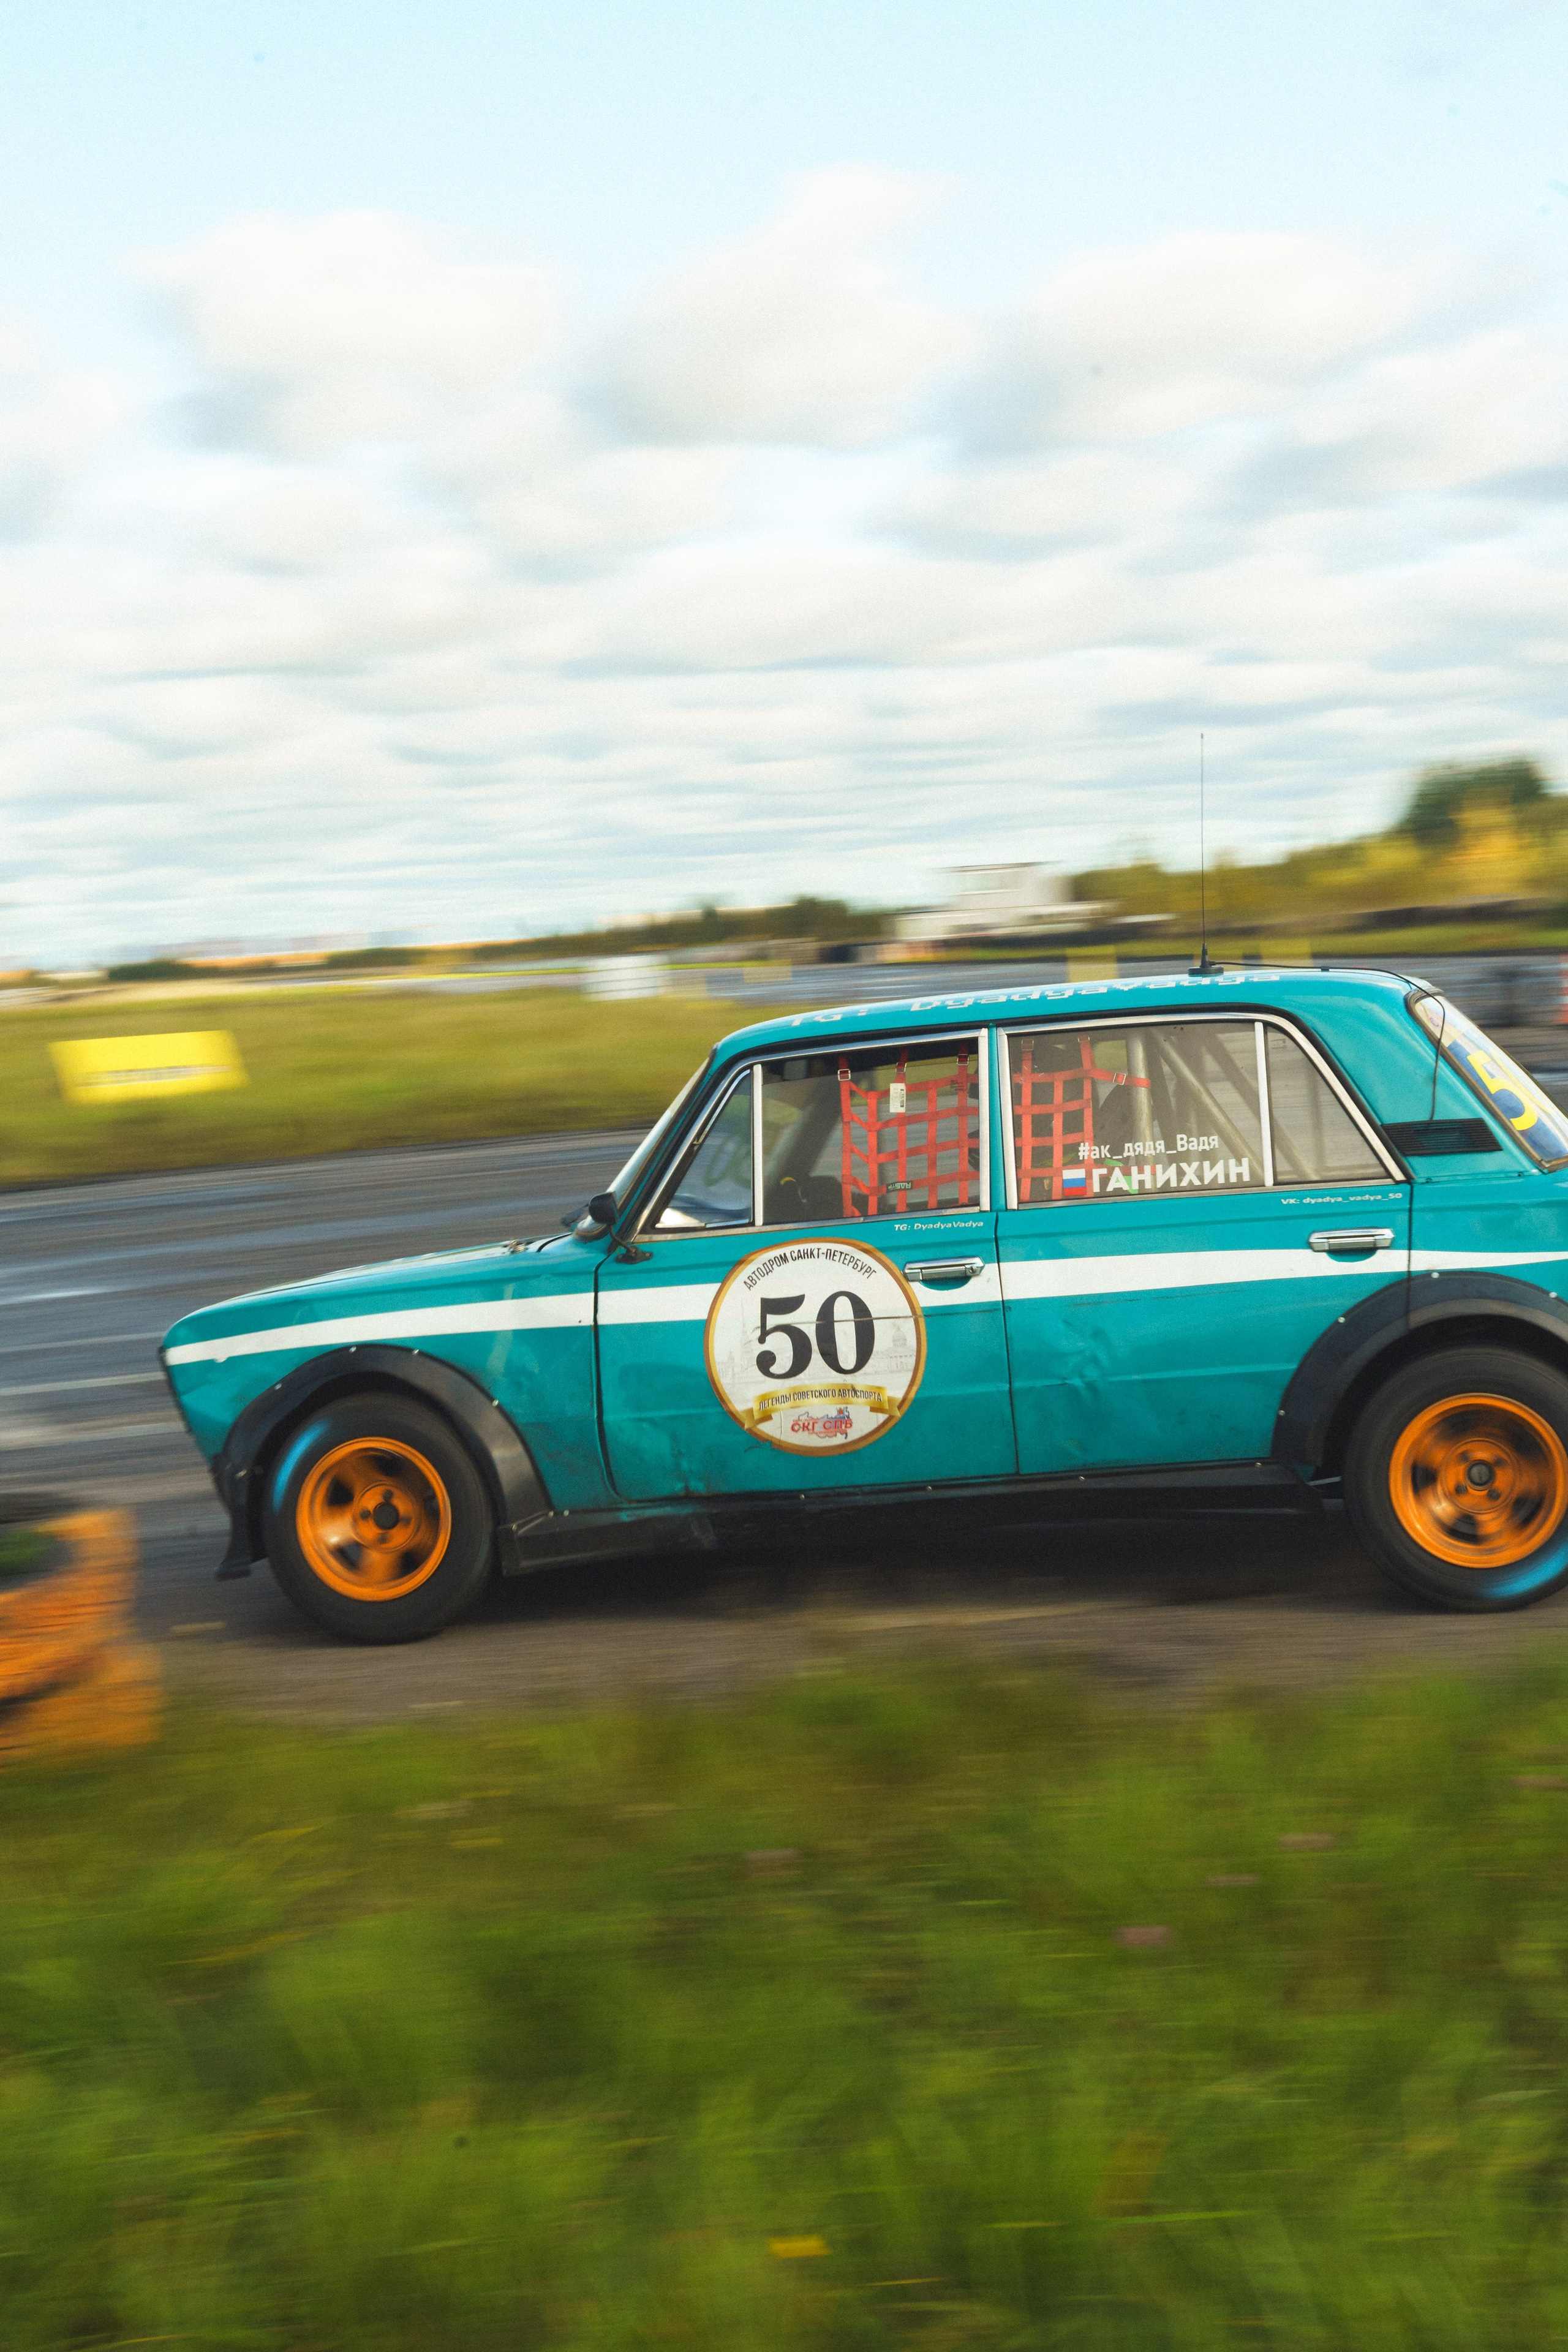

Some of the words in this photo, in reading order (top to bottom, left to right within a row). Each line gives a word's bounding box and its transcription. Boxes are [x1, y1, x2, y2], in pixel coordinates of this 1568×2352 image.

[1078, 1134, 1219, 1160] #ак_дядя_Вадя
[1092, 1158, 1251, 1193] ГАНИХИН
[914, 1221, 984, 1231] DyadyaVadya
[743, 1253, 789, 1291] АВТОДРОМ
[790, 1248, 876, 1279] САНКТ-ПЕТЕРБУРГ
[756, 1291, 875, 1379] 50
[759, 1393, 792, 1411] ЛЕГЕНДЫ
[793, 1389, 837, 1401] СОВЕТСКОГО
[838, 1389, 883, 1402] АВТОСПОРТА
